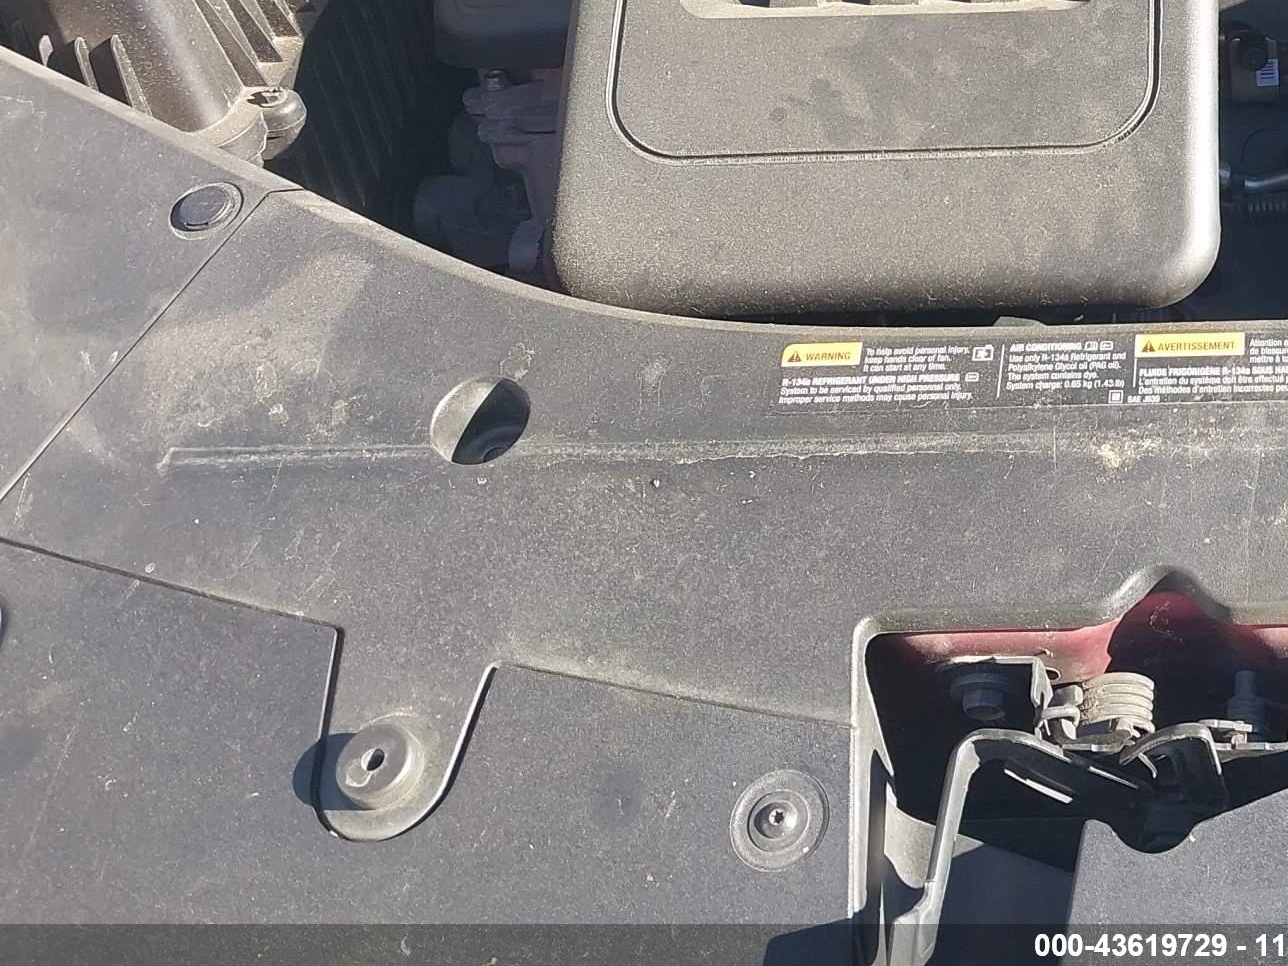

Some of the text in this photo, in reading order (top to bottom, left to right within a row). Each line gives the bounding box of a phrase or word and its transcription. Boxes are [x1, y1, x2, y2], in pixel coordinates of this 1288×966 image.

[1010, 342, 1082, 352] AIR CONDITIONING
[1158, 342, 1235, 351] AVERTISSEMENT
[1250, 338, 1282, 347] Attention
[867, 347, 875, 355] To
[876, 347, 892, 356] help
[893, 347, 914, 355] avoid
[915, 346, 947, 355] personal
[1250, 347, 1259, 355] de
[805, 352, 851, 361] WARNING
[864, 356, 883, 364] keep
[928, 354, 936, 362] of
[937, 354, 951, 362] fan.
[1009, 352, 1127, 363] Use only R-134a Refrigerant and
[1250, 355, 1274, 363] mettre
[1275, 354, 1280, 362] à
[863, 364, 869, 372] It
[904, 363, 912, 371] at
[913, 364, 927, 372] any
[1008, 361, 1121, 372] Polyalkylene Glycol oil (PAG oil).
[1140, 368, 1167, 377] FLUIDE
[1222, 366, 1250, 376] R-134a
[1252, 365, 1273, 375] SOUS
[782, 373, 960, 386] R-134a REFRIGERANT UNDER HIGH PRESSURE
[1008, 371, 1099, 381] The system contains dye.
[1139, 377, 1177, 386] L'entretien
[1179, 377, 1188, 385] du
[1190, 376, 1221, 386] système
[1222, 375, 1236, 384] doit
[1238, 375, 1253, 384] être
[1254, 374, 1284, 383] effectué
[781, 387, 808, 396] System
[819, 386, 829, 394] be
[830, 385, 861, 394] serviced
[863, 385, 872, 394] by
[874, 384, 905, 393] qualified
[906, 383, 943, 392] personnel
[945, 382, 961, 391] only.
[1006, 379, 1125, 391] System charge: 0.65 kg (1.43 lb)
[1138, 386, 1153, 394] Des
[1154, 386, 1191, 395] méthodes
[1192, 385, 1232, 394] d'entretien
[1233, 384, 1274, 392] incorrectes
[779, 392, 973, 405] Improper service methods may cause personal injury.
